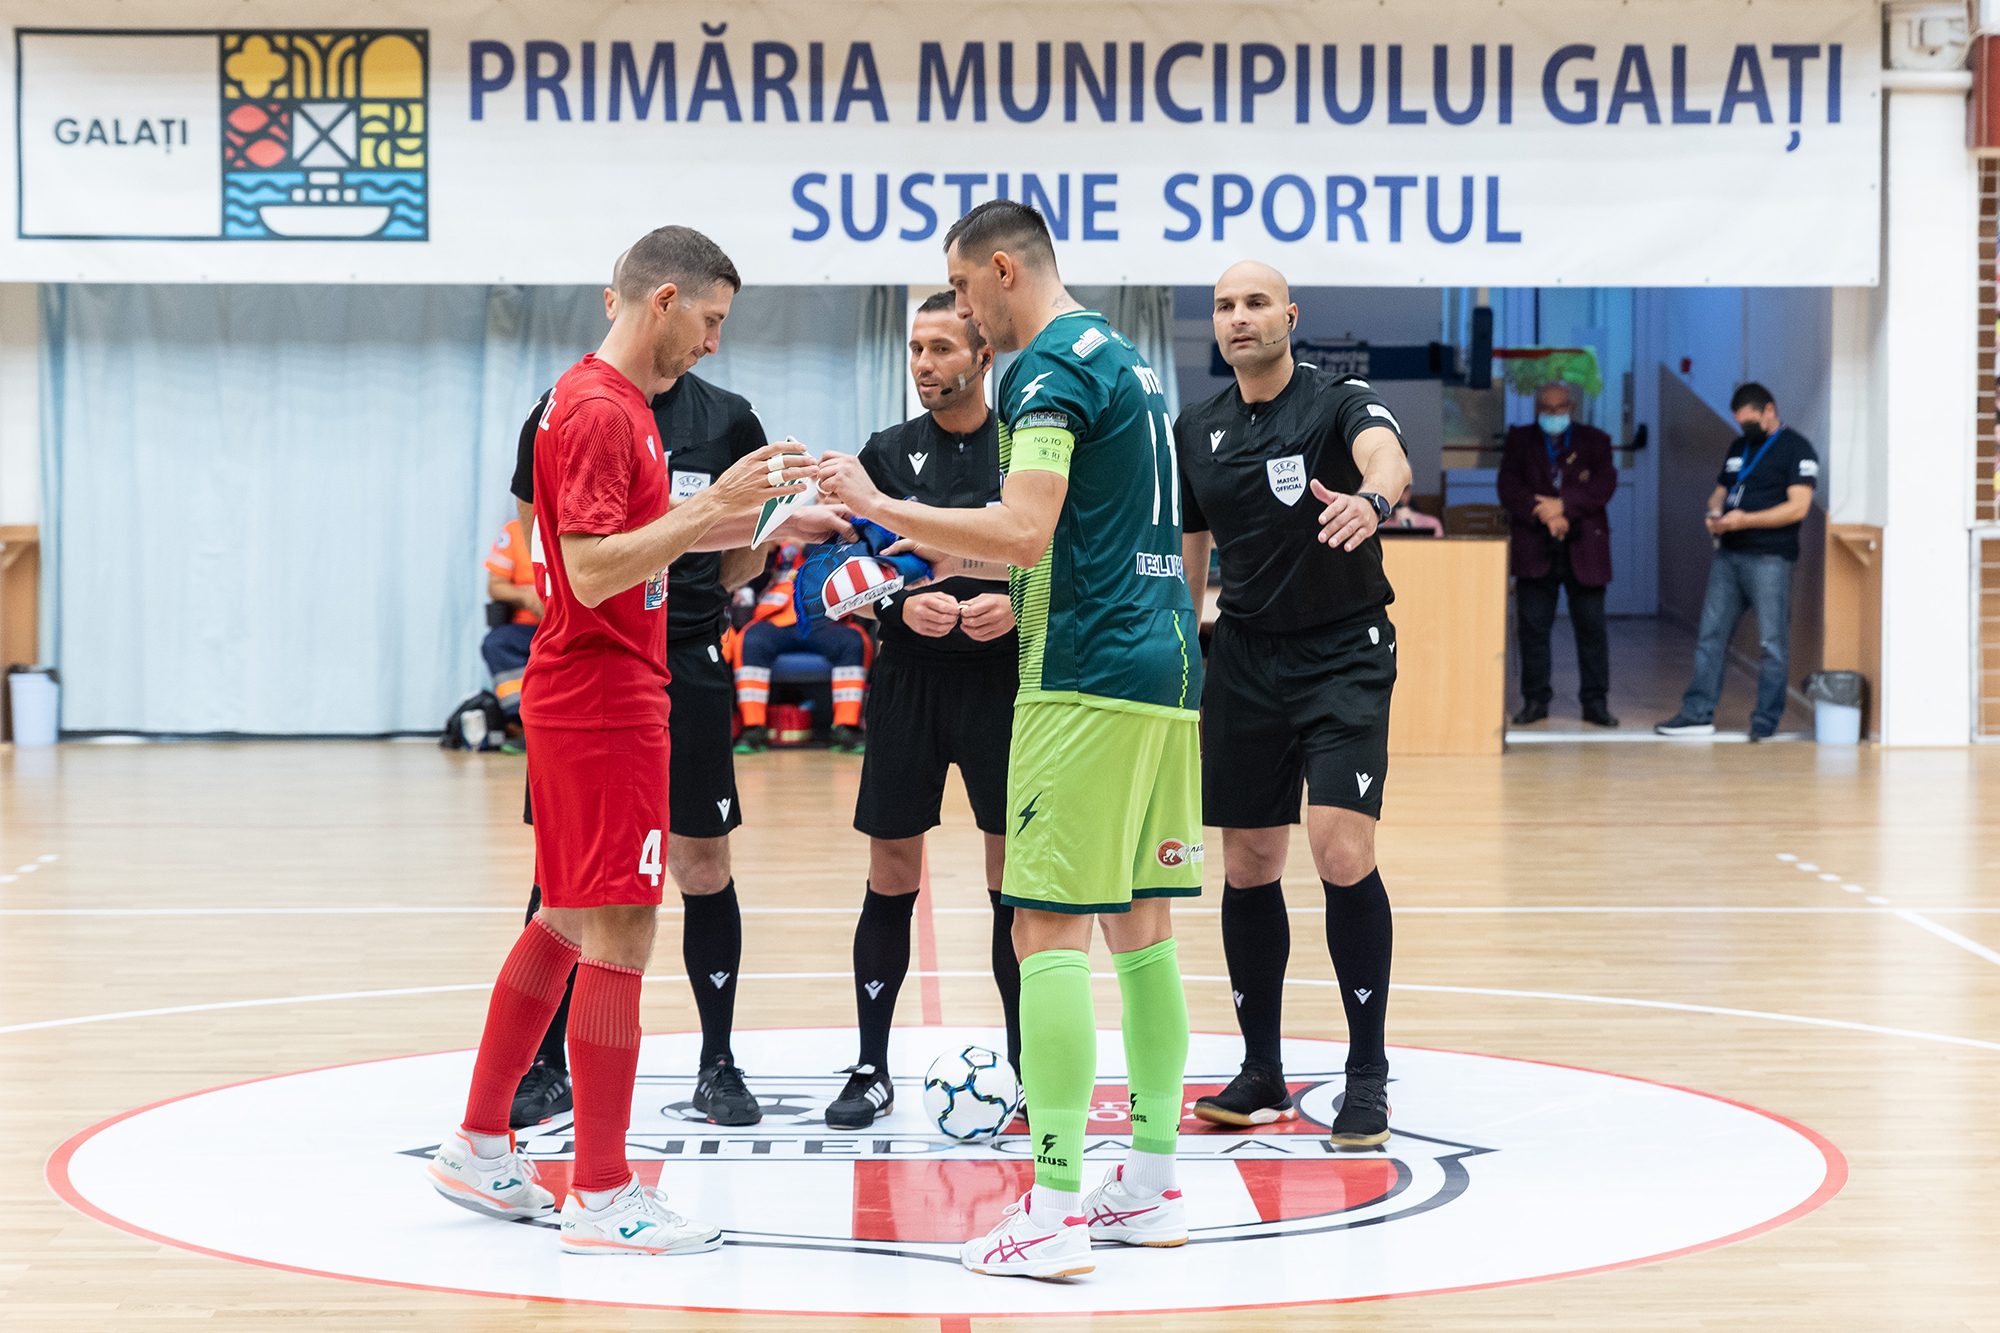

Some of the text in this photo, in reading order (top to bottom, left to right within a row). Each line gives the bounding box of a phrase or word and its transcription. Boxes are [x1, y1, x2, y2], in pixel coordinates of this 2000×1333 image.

[468, 22, 1843, 153] PRIMĂRIA MUNICIPIULUI GALAȚI
[54, 117, 187, 154] GALAȚI
[1163, 172, 1522, 244] SPORTUL
[1033, 436, 1062, 446] NO TO
[1147, 410, 1179, 527] 11
[1273, 462, 1296, 474] UEFA
[679, 477, 702, 488] UEFA
[1276, 476, 1299, 485] MATCH
[1275, 483, 1303, 493] OFFICIAL
[638, 829, 662, 886] 4
[1130, 1114, 1147, 1123] EUS
[1037, 1154, 1068, 1167] ZEUS
